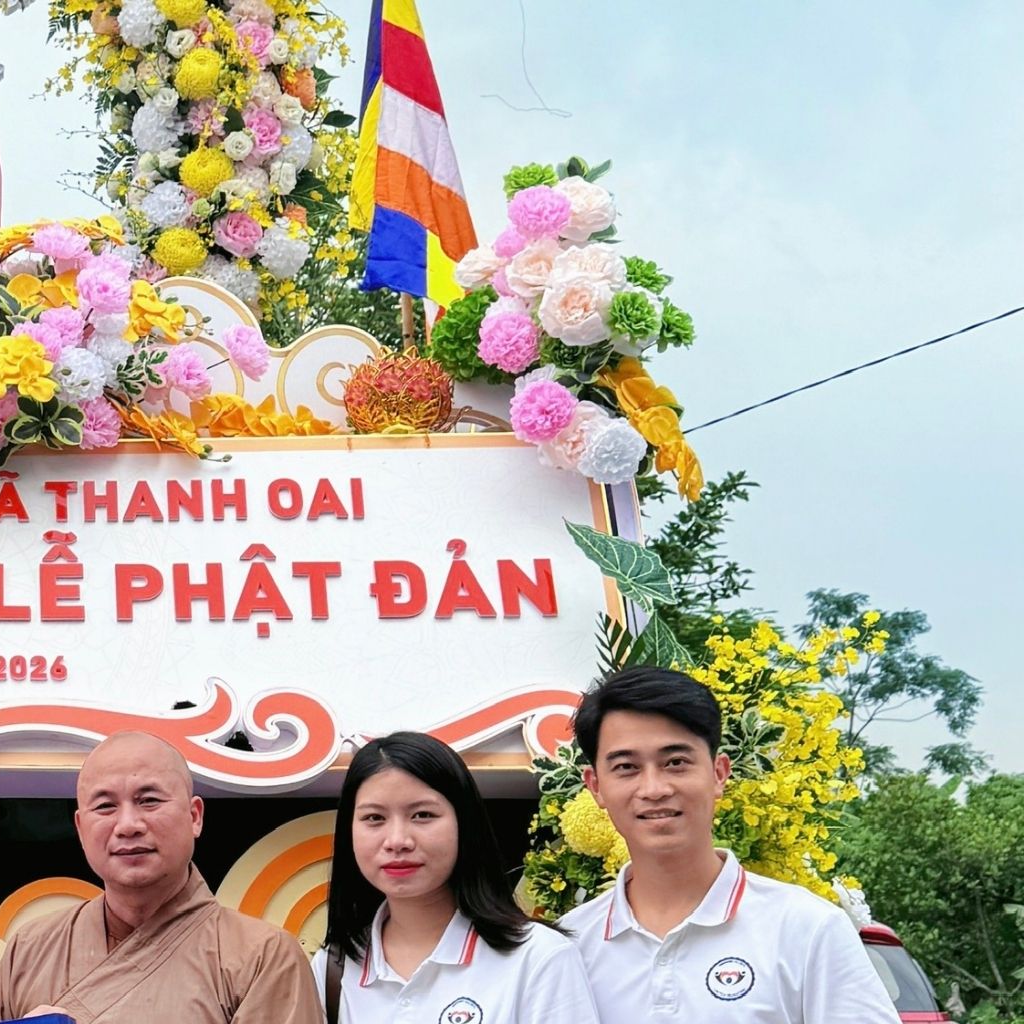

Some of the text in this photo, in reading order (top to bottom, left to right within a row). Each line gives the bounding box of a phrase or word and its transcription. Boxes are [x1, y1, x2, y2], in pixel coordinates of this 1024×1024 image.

[43, 478, 248, 523] THANH
[267, 477, 366, 521] OAI
[115, 542, 342, 638] PHẬT
[369, 538, 559, 620] ĐẢN
